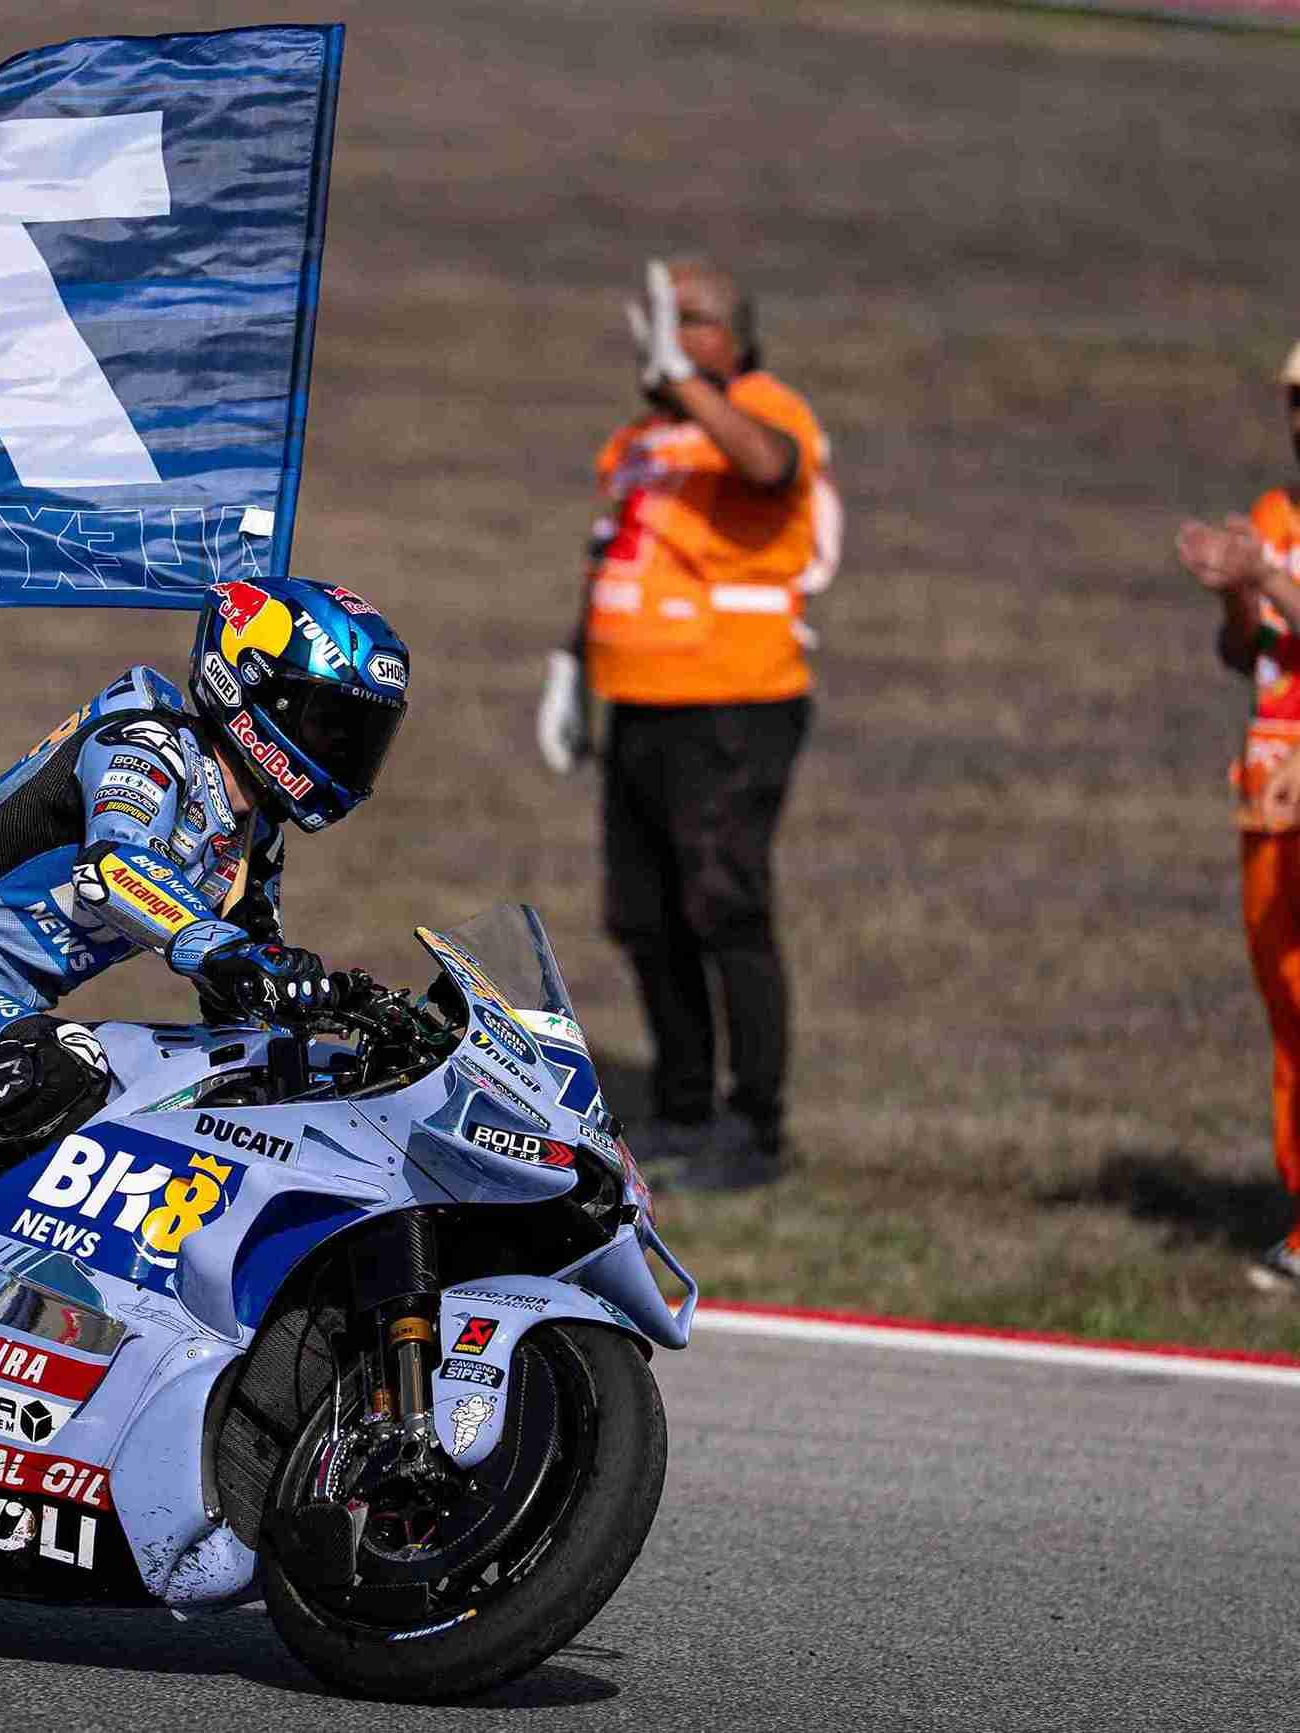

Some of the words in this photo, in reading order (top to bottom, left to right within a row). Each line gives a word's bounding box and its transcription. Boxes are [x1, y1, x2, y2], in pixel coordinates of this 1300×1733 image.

[294, 611, 350, 670] TONIT
[206, 658, 238, 700] SHOEI
[378, 660, 405, 683] SHOE
[114, 755, 151, 771] BOLD
[106, 866, 184, 923] Antangin
[166, 880, 208, 912] NEWS
[23, 900, 97, 973] NEWS
[194, 1112, 295, 1163] DUCATI
[474, 1125, 542, 1154] BOLD
[10, 1208, 101, 1258] NEWS
[447, 1287, 552, 1305] MOTO-TRON
[492, 1299, 547, 1313] RACING
[444, 1366, 497, 1386] SIPEX
[449, 1359, 498, 1376] CAVAGNA
[41, 1462, 107, 1506] OIL
